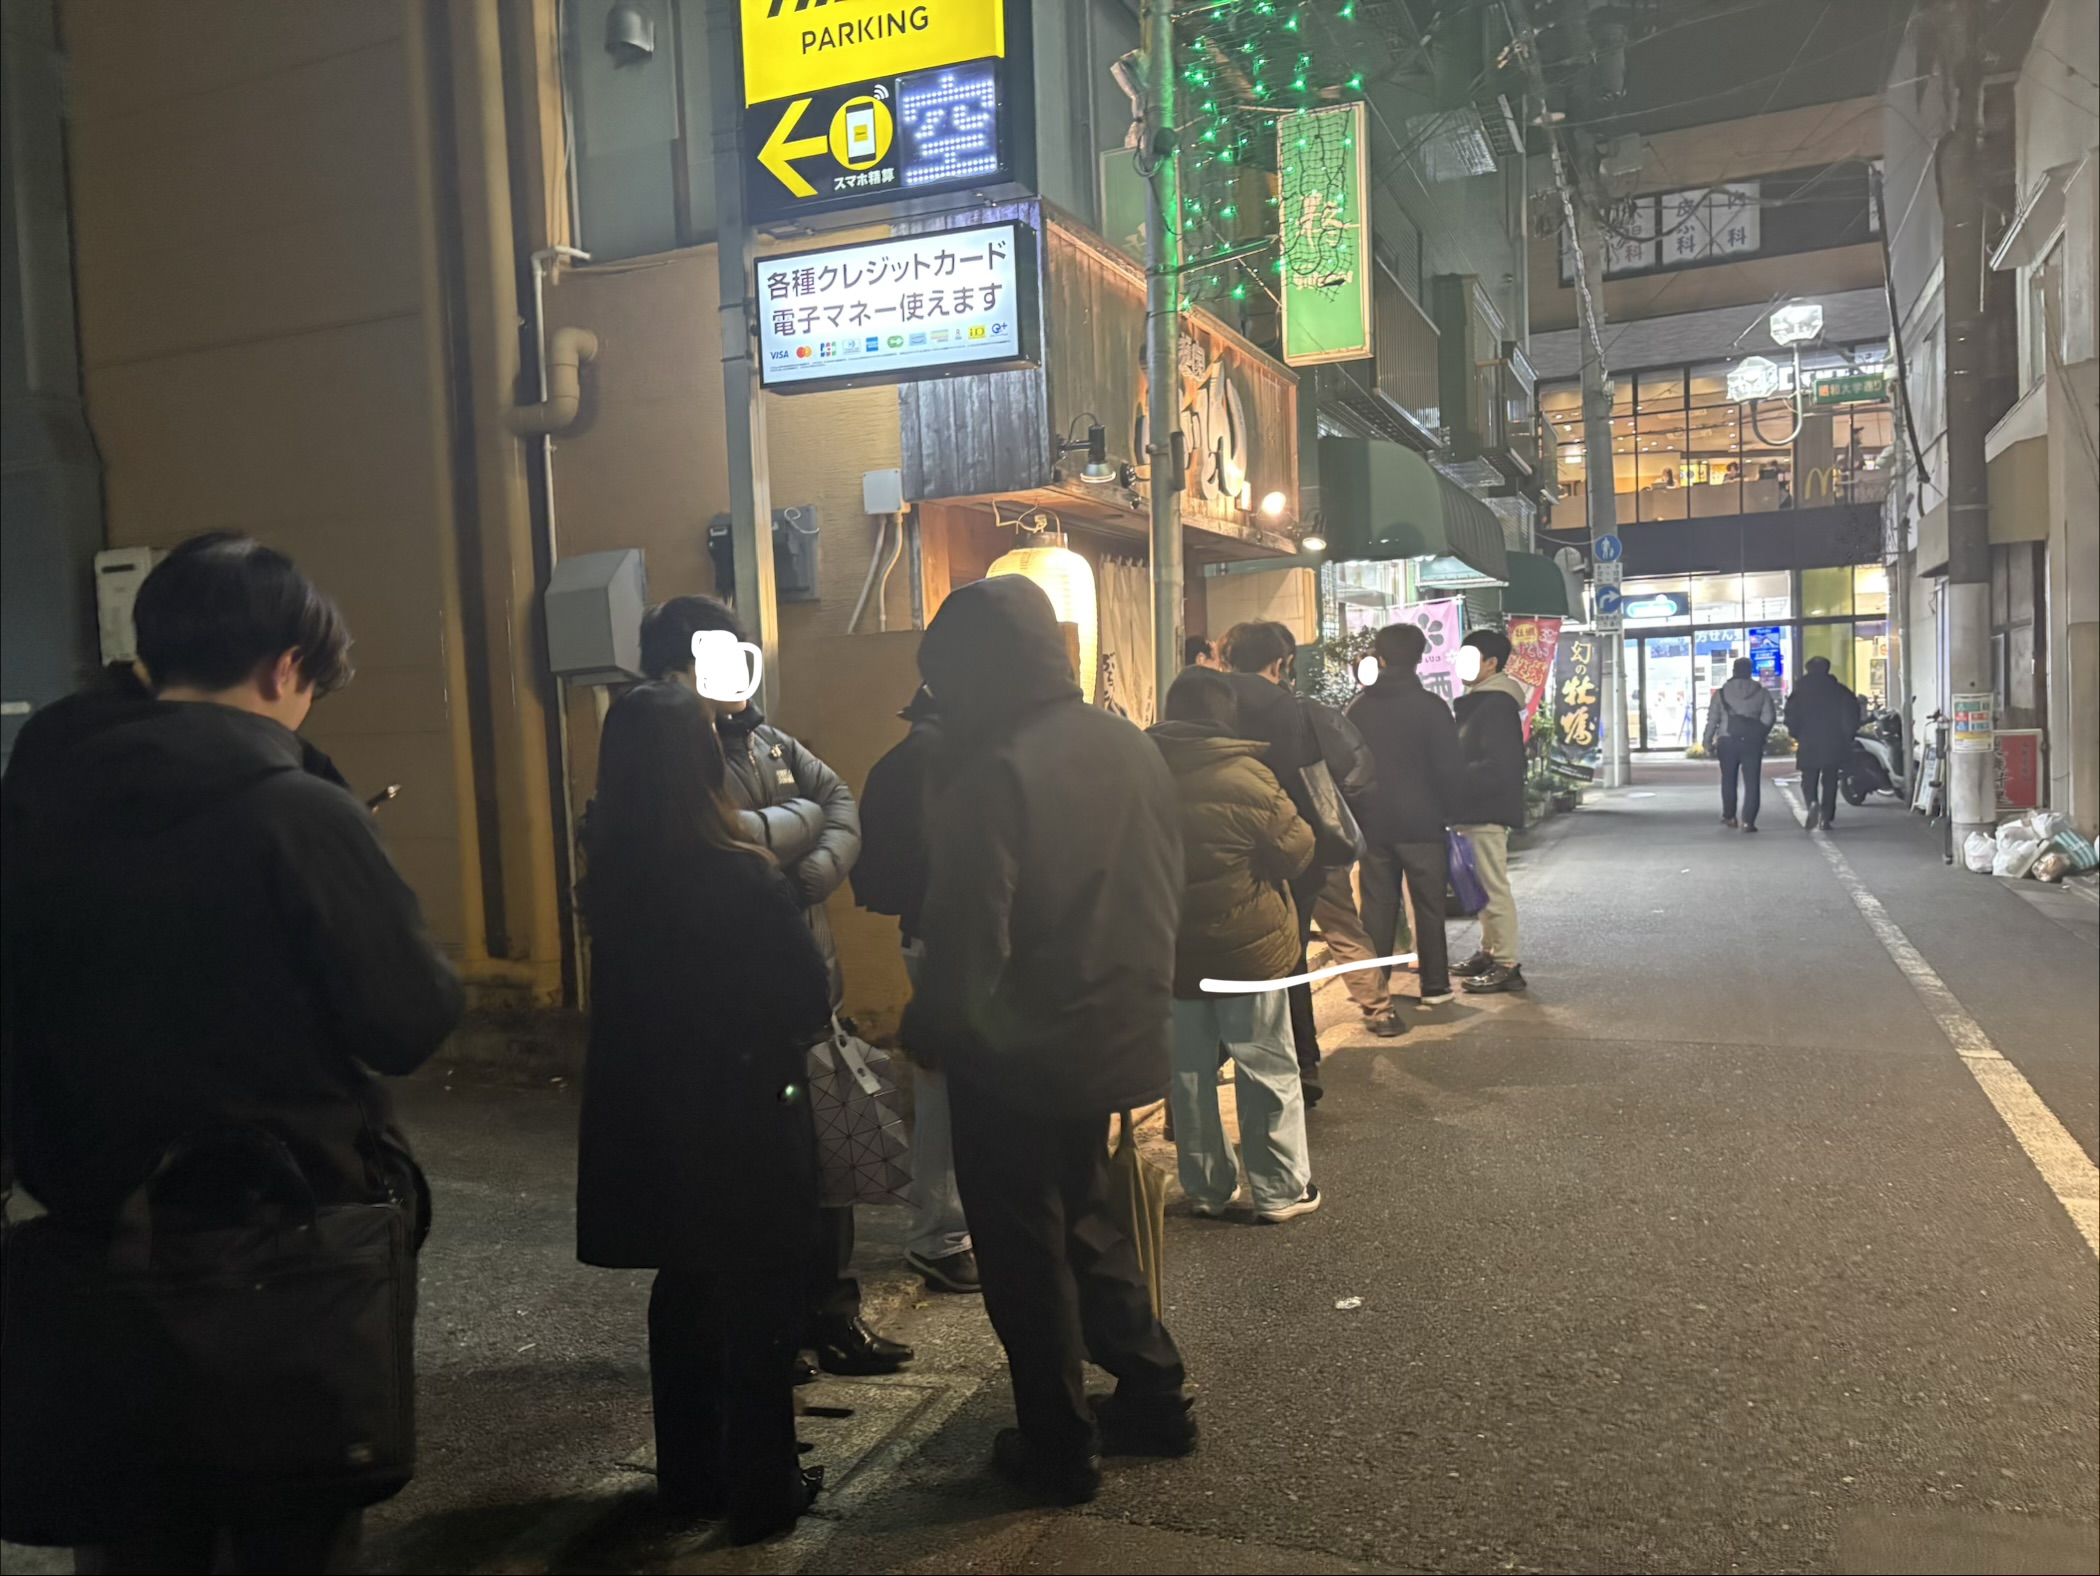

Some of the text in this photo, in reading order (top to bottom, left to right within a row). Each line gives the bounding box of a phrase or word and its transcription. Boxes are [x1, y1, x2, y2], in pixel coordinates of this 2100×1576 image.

[802, 5, 929, 55] PARKING
[903, 75, 997, 185] 空
[834, 167, 895, 190] スマホ精算
[766, 240, 1007, 301] 各種クレジットカード
[772, 282, 1003, 337] 電子マネー使えます
[770, 350, 789, 360] VISA
